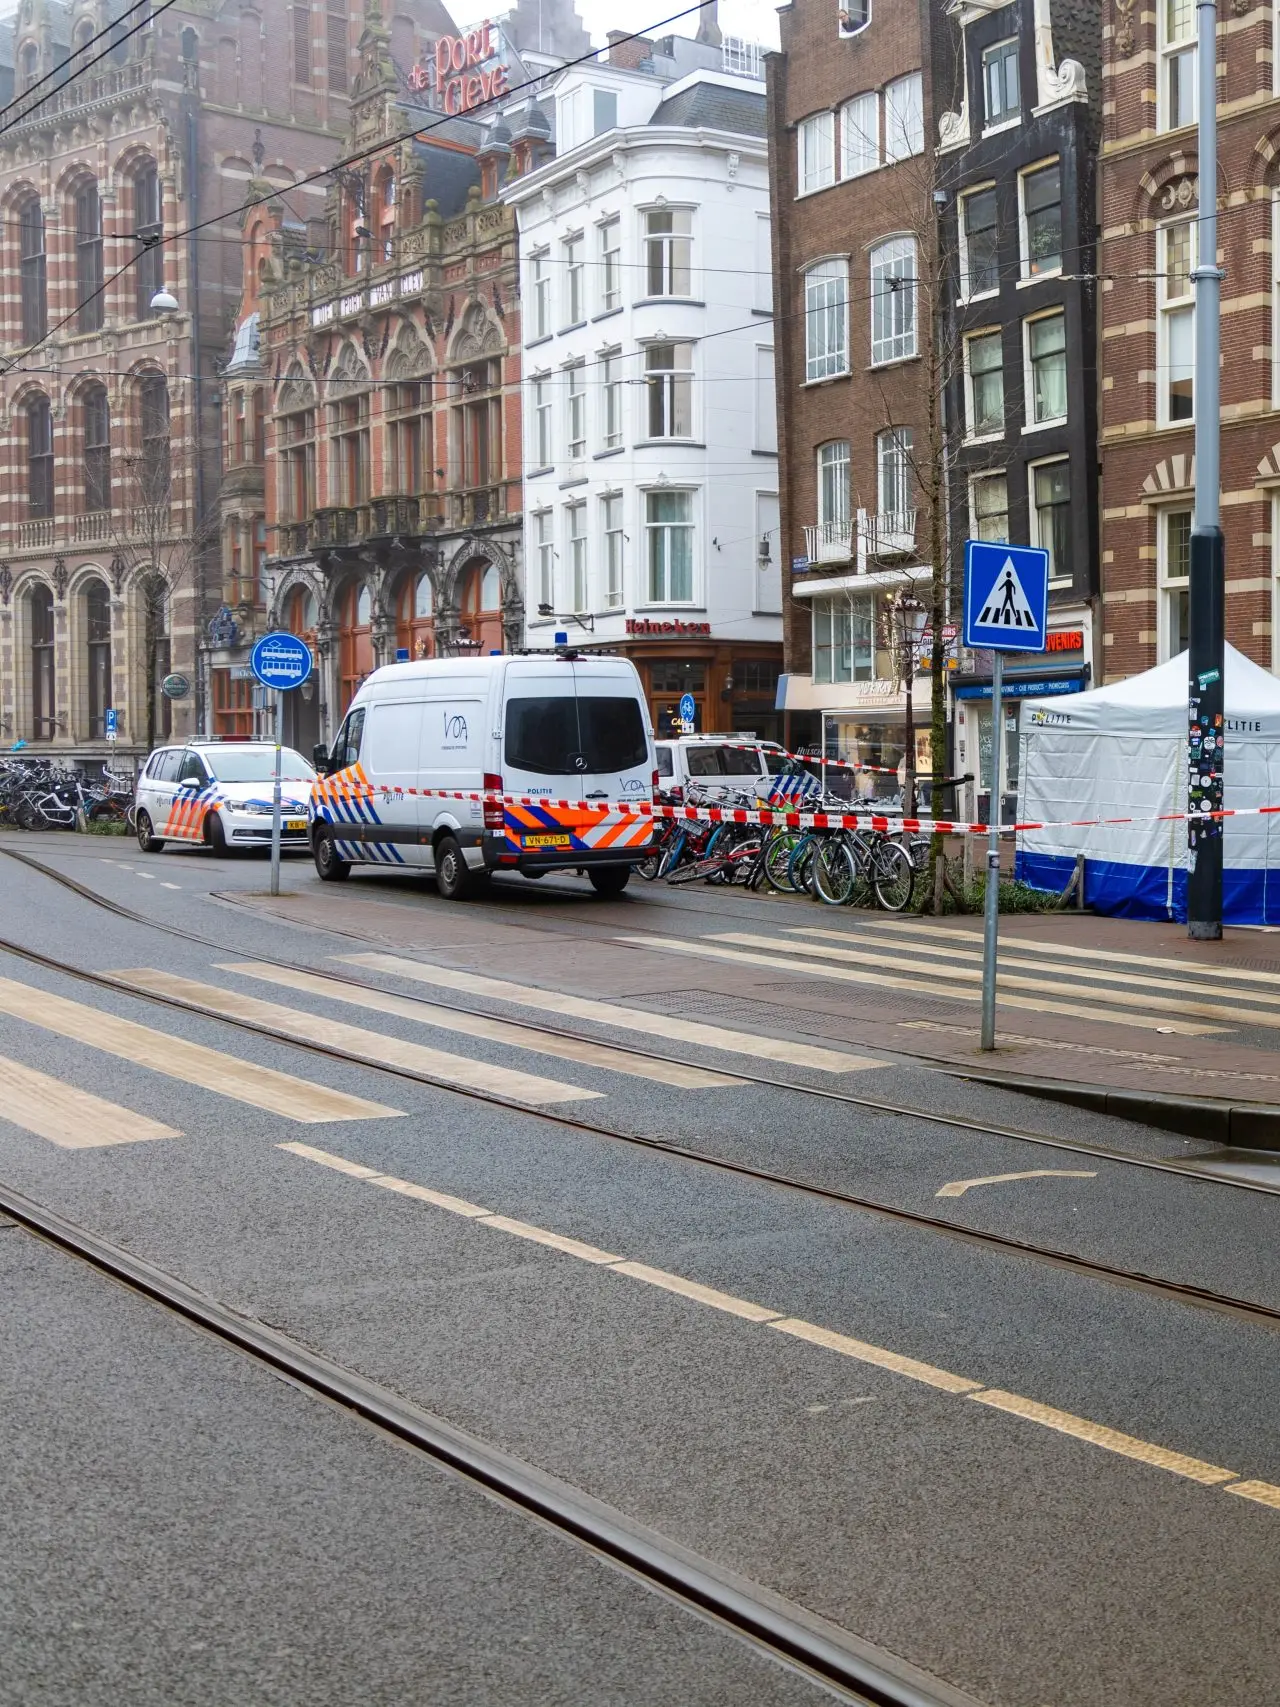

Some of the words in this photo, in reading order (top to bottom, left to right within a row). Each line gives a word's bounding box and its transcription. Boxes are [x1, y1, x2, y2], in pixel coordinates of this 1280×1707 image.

[625, 618, 712, 635] Heineken
[1046, 631, 1082, 652] UVENIRS
[528, 835, 566, 845] VN-671-D
